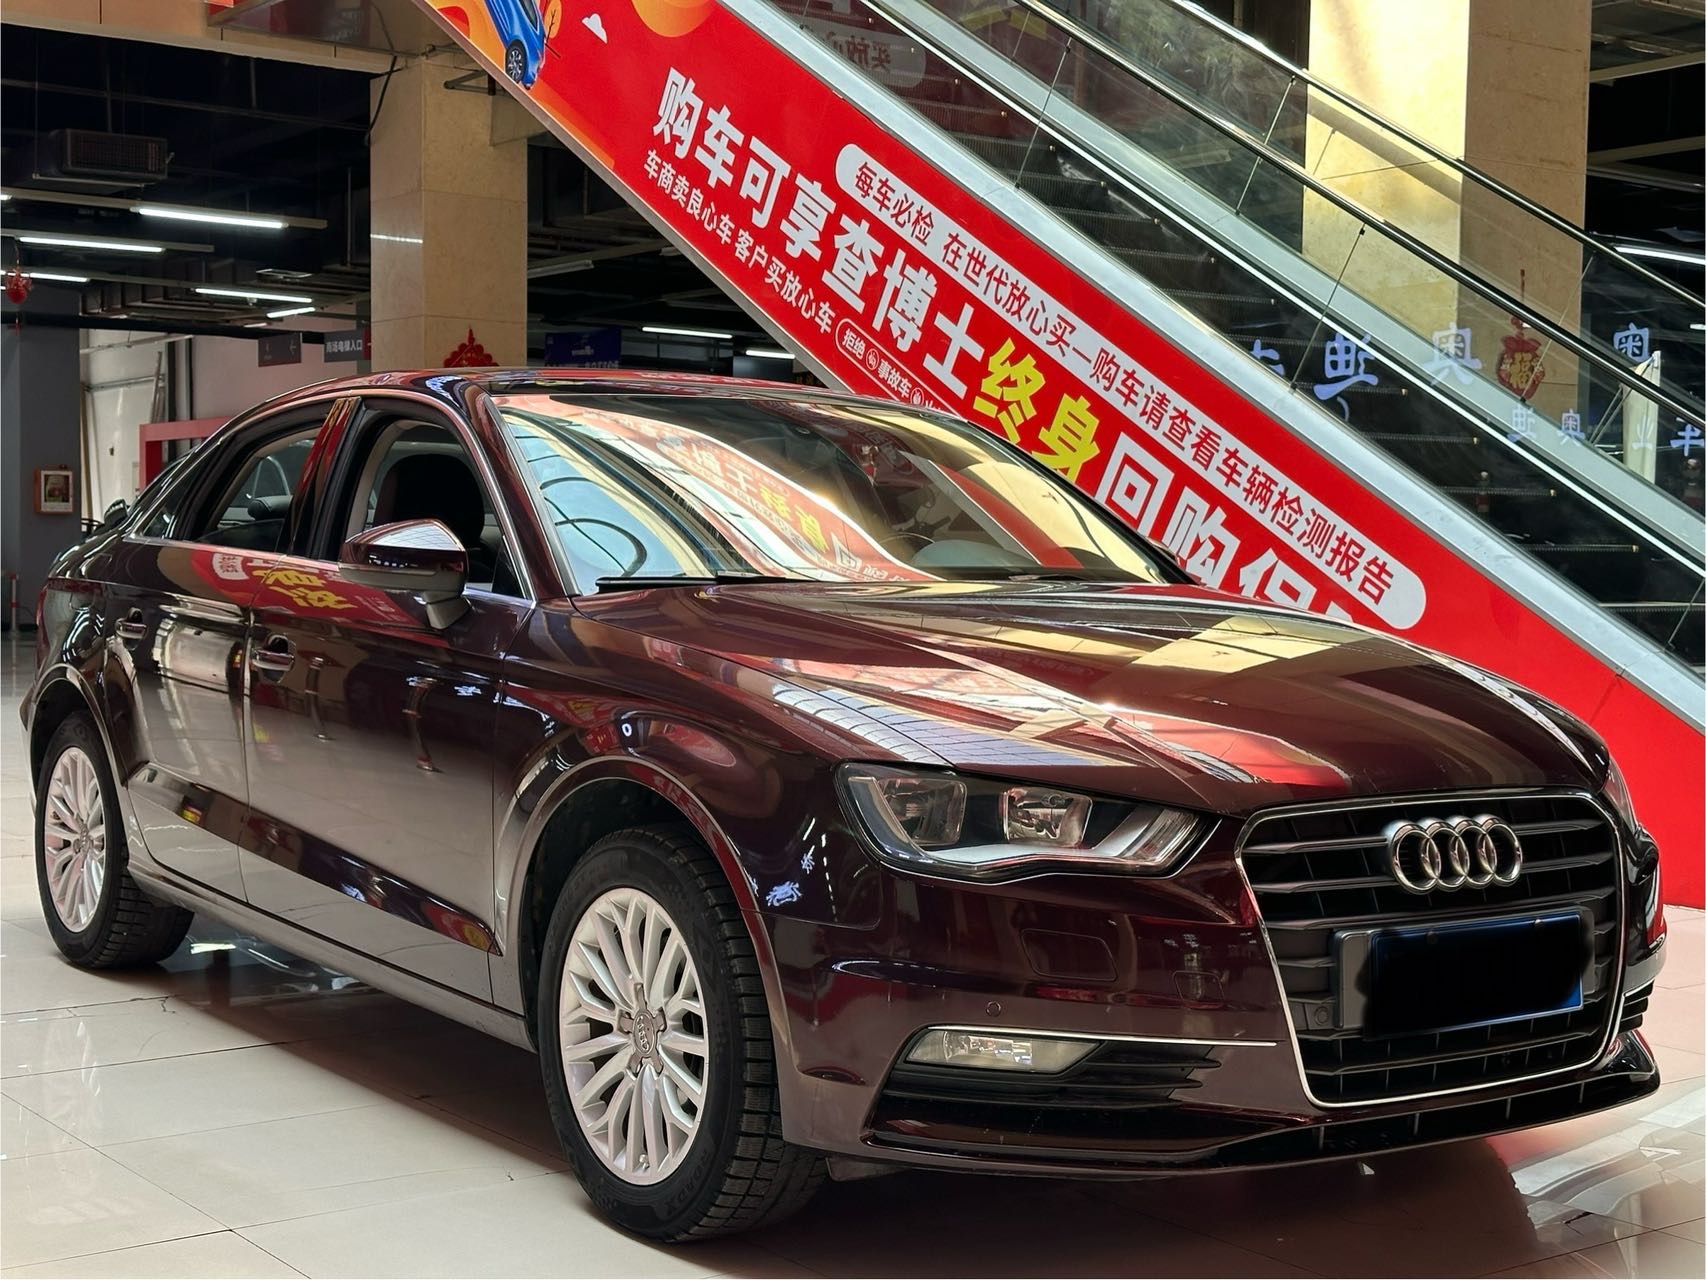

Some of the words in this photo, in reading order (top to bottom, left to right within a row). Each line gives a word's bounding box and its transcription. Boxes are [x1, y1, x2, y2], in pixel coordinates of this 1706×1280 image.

[643, 149, 735, 245] 车商卖良心车
[734, 230, 837, 334] 客户买放心车
[855, 162, 934, 247] 每车必检
[653, 66, 1353, 623] 购车可享查博士终身回购
[842, 328, 866, 360] 拒绝
[877, 358, 912, 398] 事故车
